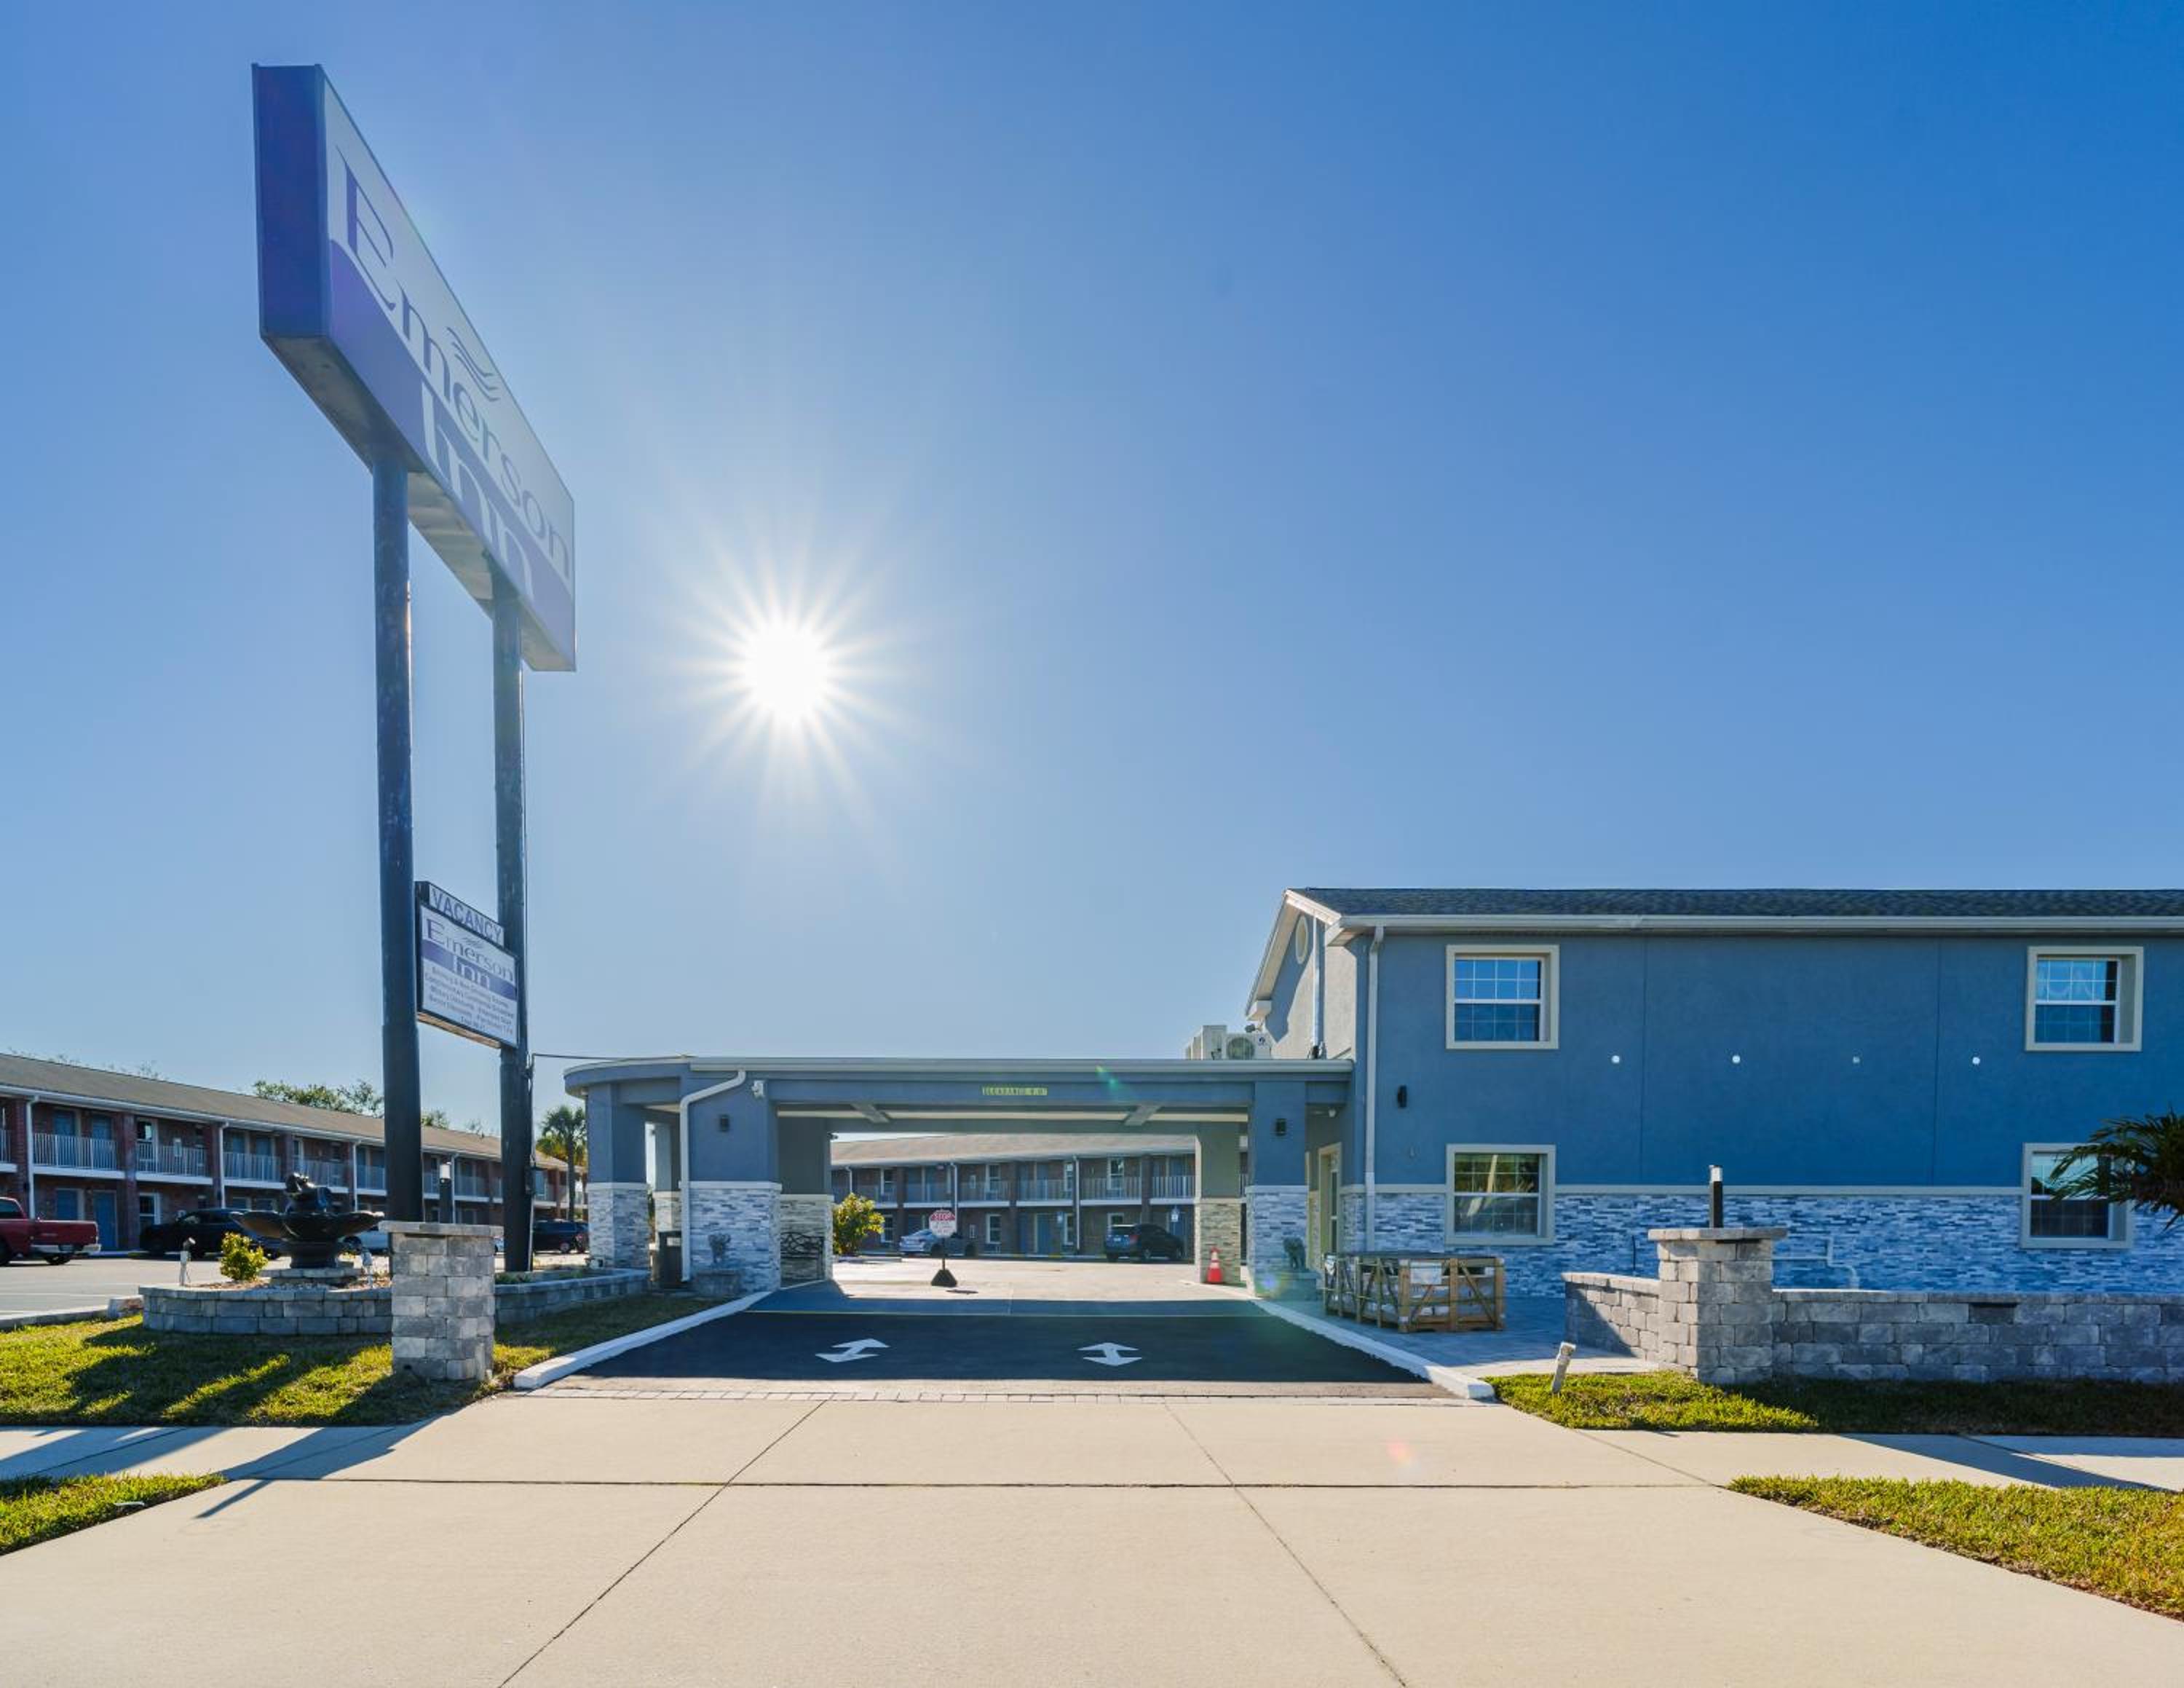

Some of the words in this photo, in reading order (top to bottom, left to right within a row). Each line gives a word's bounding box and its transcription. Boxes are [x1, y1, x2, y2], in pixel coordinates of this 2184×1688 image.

[336, 146, 571, 575] Emerson
[422, 379, 536, 602] Inn
[431, 888, 502, 942] VACANCY
[427, 918, 514, 982] Emerson
[453, 955, 491, 988] Inn
